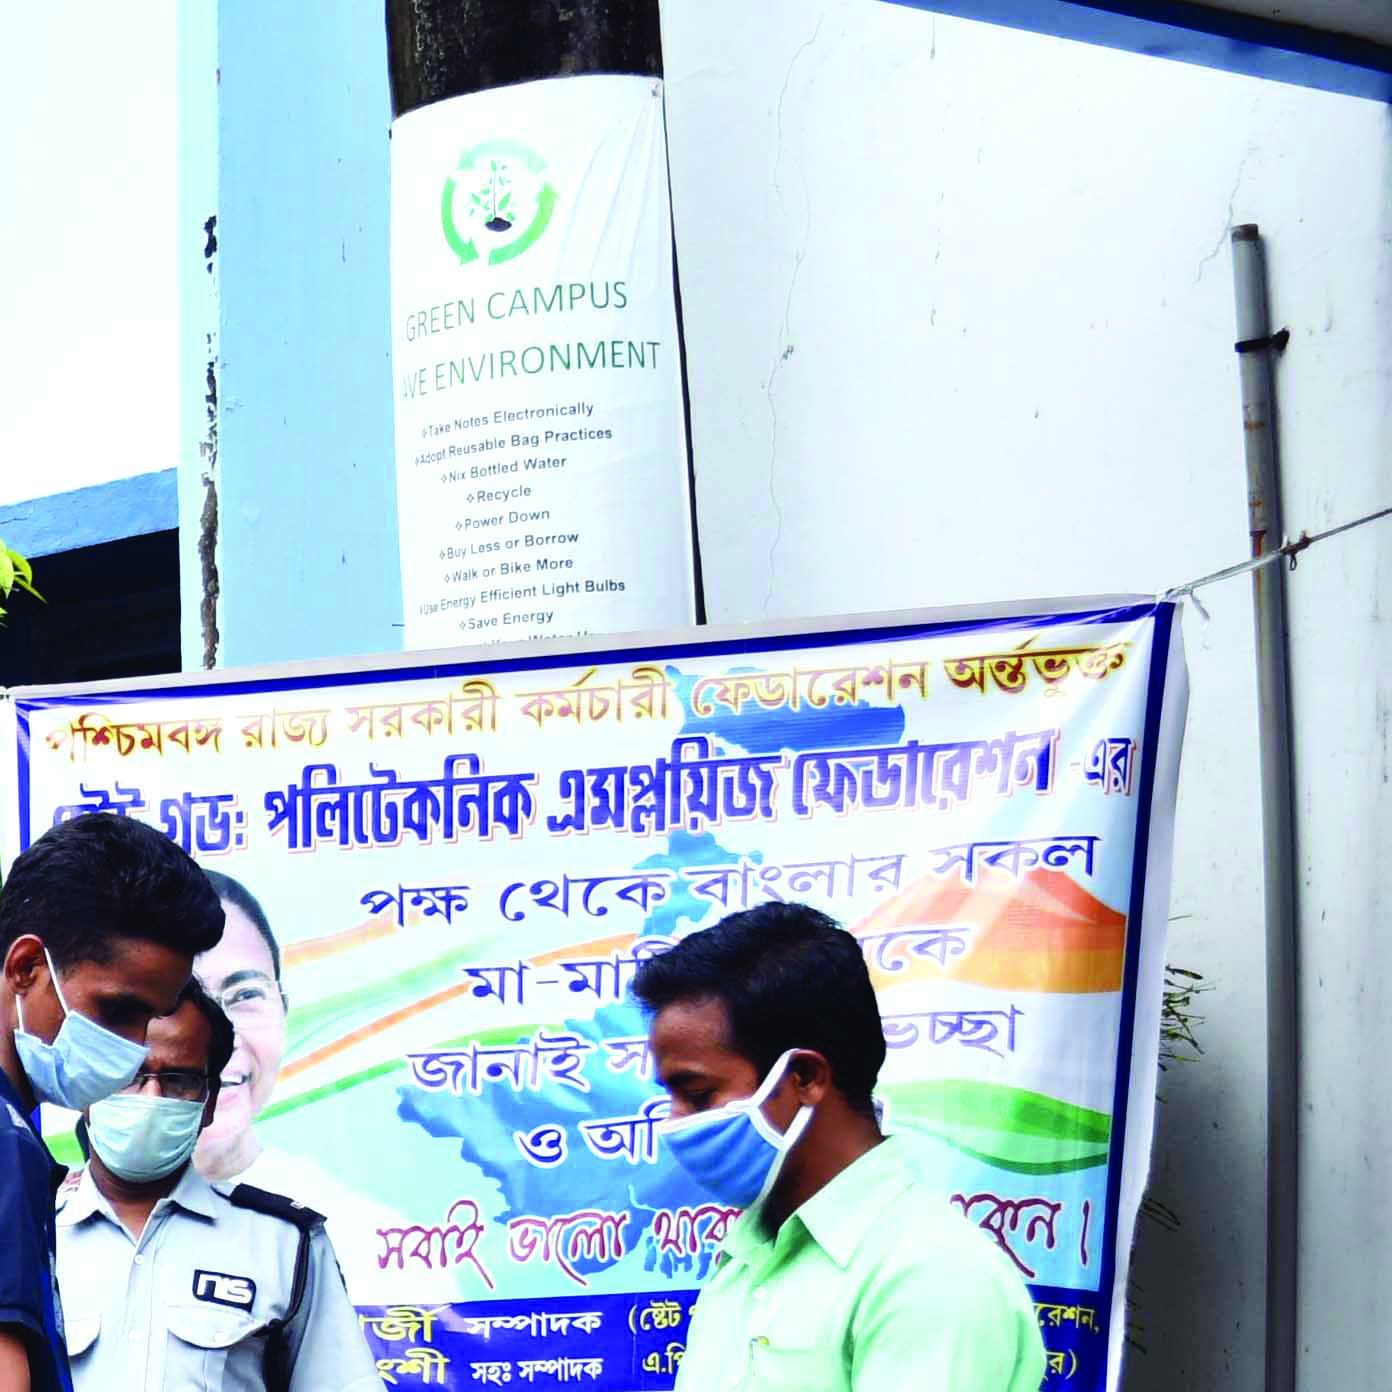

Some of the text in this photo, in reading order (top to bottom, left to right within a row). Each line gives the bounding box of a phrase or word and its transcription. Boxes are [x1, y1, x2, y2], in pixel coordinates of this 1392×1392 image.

[406, 281, 627, 342] GREEN CAMPUS
[435, 340, 661, 391] ENVIRONMENT
[427, 402, 594, 438] Take Notes Electronically
[449, 438, 506, 457] Reusable
[511, 434, 540, 448] Bag
[544, 427, 613, 444] Practices
[449, 456, 567, 482] Nix Bottled Water
[477, 485, 532, 503] Recycle
[464, 509, 550, 529] Power Down
[447, 532, 579, 560] Buy Less or Borrow
[452, 558, 574, 583] Walk or Bike More
[440, 594, 476, 610] Energy
[480, 584, 537, 604] Efficient
[542, 580, 580, 598] Light
[585, 578, 626, 593] Bulbs
[468, 610, 554, 630] Save Energy
[45, 711, 223, 763] পশ্চিমবঙ্গ
[237, 708, 332, 750] রাজ্য
[347, 679, 504, 741] সরকারী
[515, 665, 675, 728] কর্মচারী
[692, 659, 930, 717] ফেডারেশন
[264, 754, 536, 849] পলিটেকনিক
[793, 730, 1057, 816] ফেডারেশন
[360, 835, 1100, 927] পক্ষ থেকে বাংলার সকল
[406, 1031, 591, 1089] জানাই
[519, 1128, 563, 1164] ও
[376, 1200, 494, 1289] সবাই
[510, 1212, 628, 1286] ভালো
[465, 1311, 602, 1342] সম্পাদক
[517, 1357, 604, 1383] সম্পাদক
